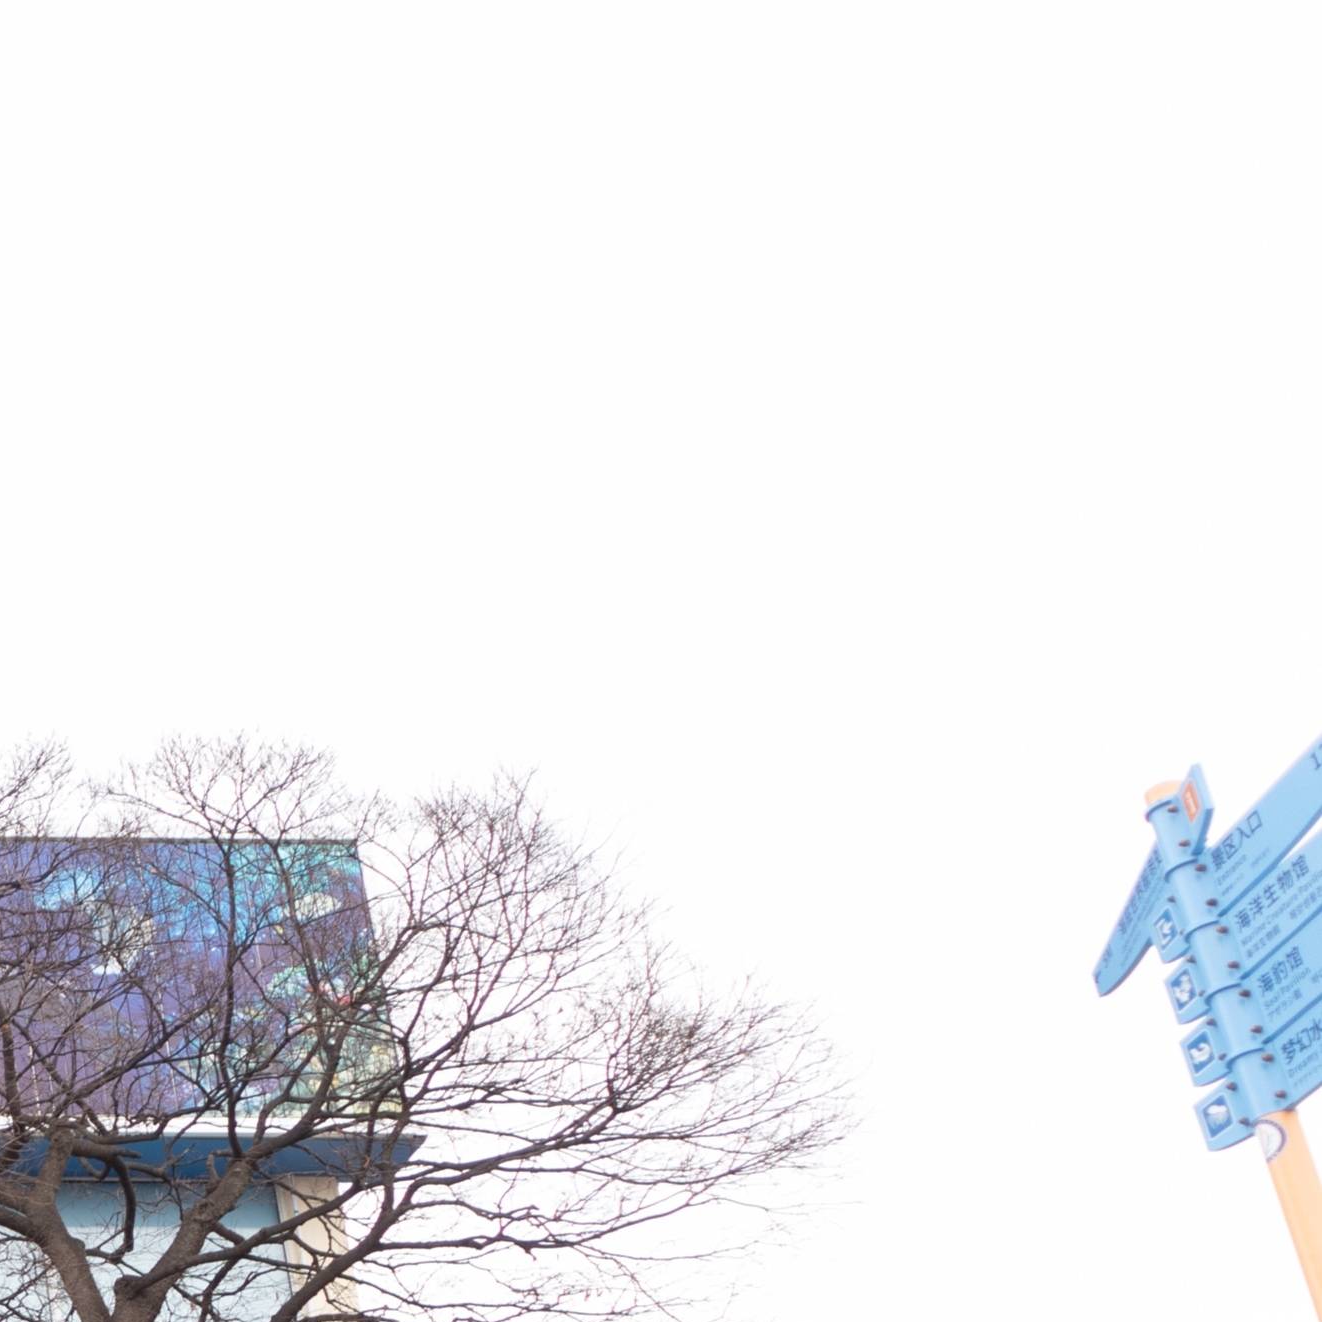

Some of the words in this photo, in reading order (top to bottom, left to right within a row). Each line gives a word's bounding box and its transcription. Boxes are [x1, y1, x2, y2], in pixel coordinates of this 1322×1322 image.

[1235, 854, 1309, 933] 海洋生物馆
[1258, 946, 1304, 996] 海豹馆
